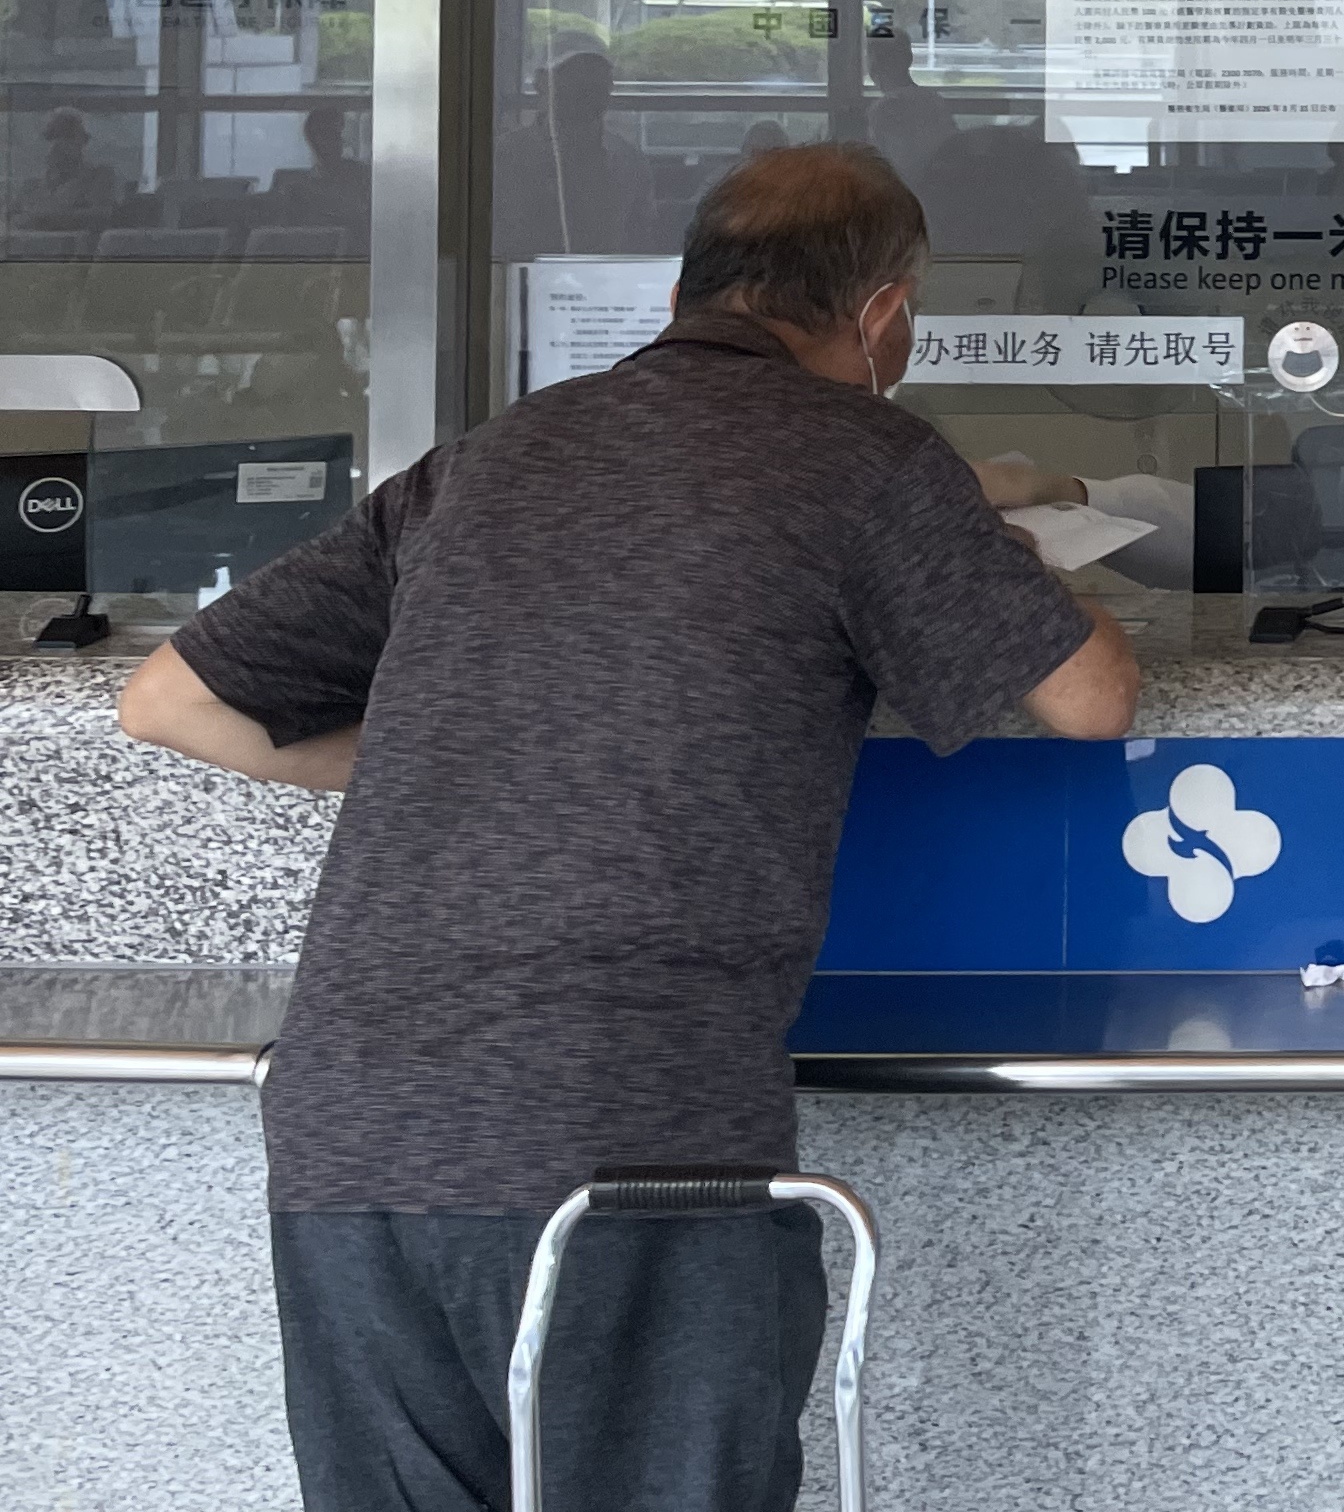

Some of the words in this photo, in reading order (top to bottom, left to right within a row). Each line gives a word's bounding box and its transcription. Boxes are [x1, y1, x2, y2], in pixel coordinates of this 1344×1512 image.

[1102, 266, 1188, 290] Please
[1199, 266, 1261, 295] keep
[1270, 272, 1325, 291] one
[913, 330, 1062, 367] 办理业务
[1087, 331, 1237, 368] 请先取号
[27, 497, 77, 513] DELL
